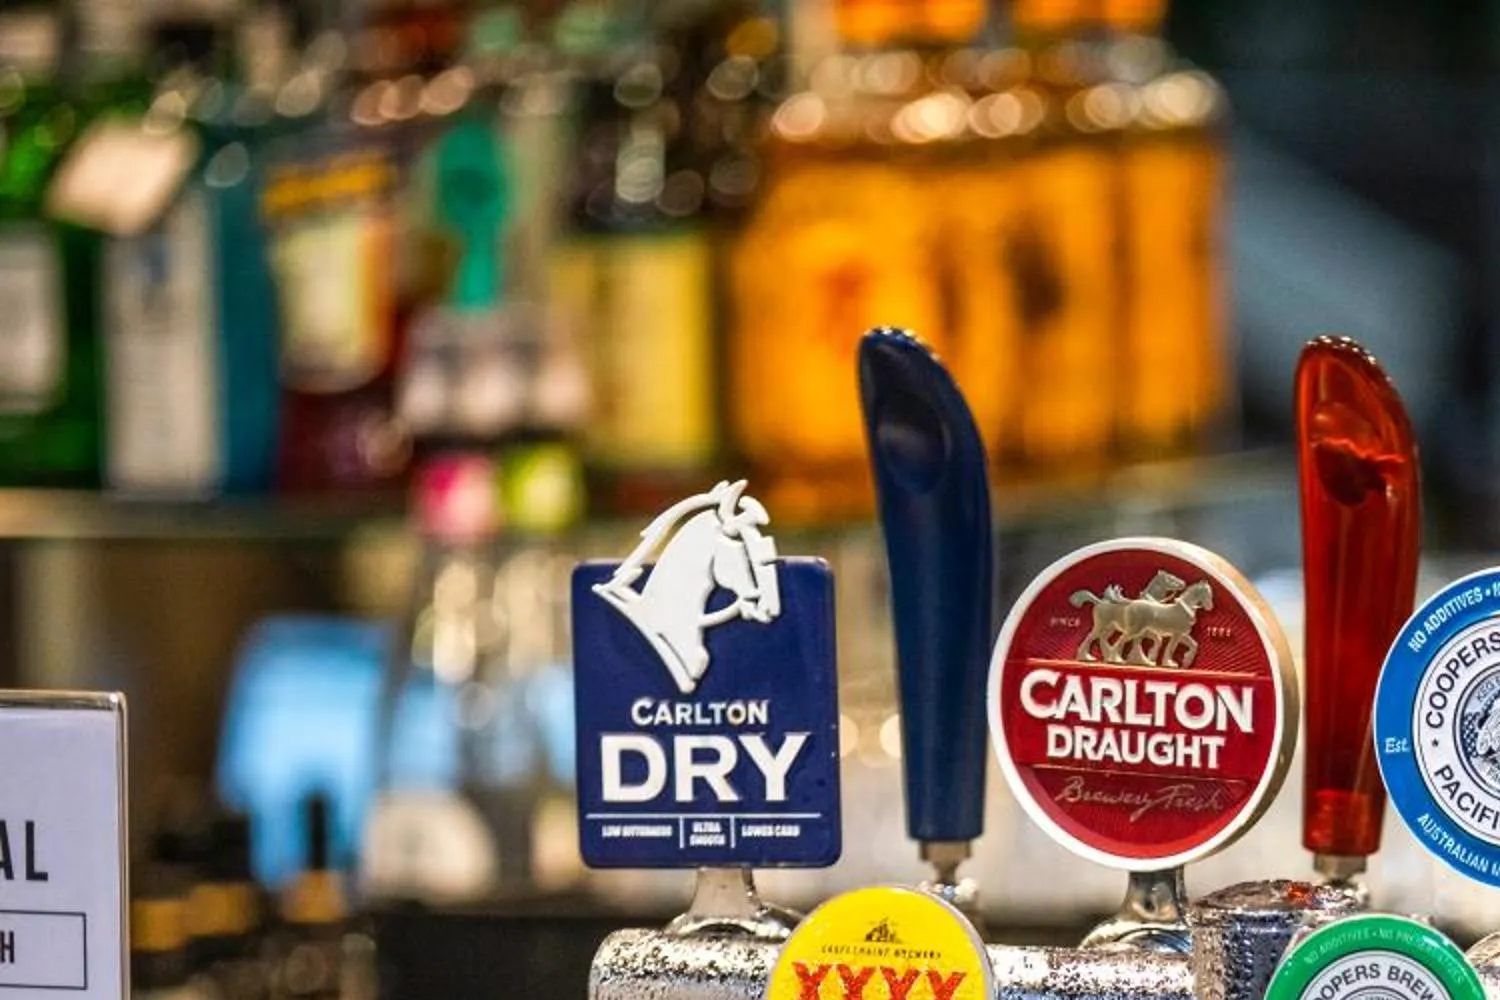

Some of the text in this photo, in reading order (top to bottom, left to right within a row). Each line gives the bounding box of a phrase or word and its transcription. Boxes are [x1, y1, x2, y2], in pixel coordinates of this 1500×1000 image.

[1408, 632, 1427, 653] NO
[1423, 586, 1484, 632] ADDITIVES
[631, 698, 769, 726] CARLTON
[1020, 669, 1254, 733] CARLTON
[600, 732, 811, 803] DRY
[1046, 725, 1226, 769] DRAUGHT
[1054, 775, 1152, 822] Brewery
[1416, 812, 1489, 874] AUSTRALIAN
